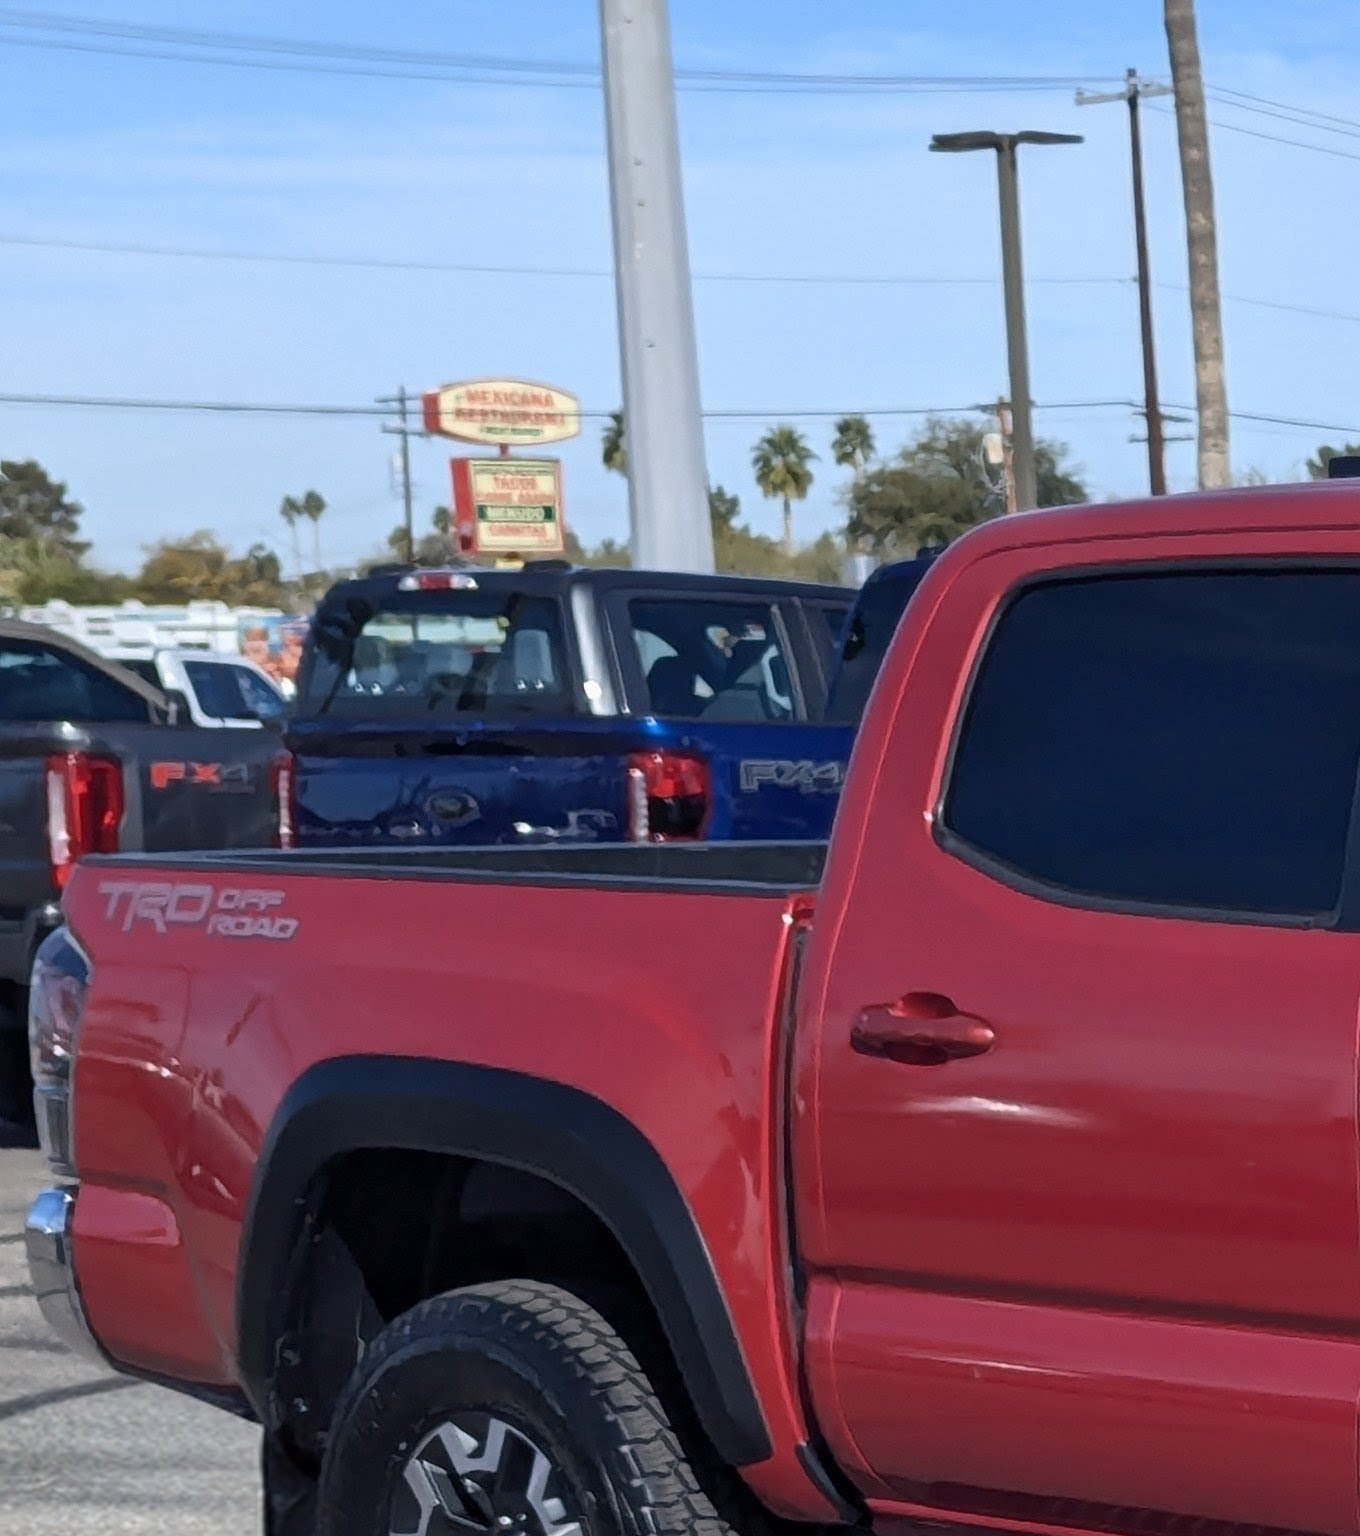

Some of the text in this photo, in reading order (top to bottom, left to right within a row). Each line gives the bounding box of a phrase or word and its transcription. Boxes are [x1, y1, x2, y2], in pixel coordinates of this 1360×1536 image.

[465, 389, 555, 407] MEXICANA
[98, 882, 286, 934] TRD OFF
[206, 913, 299, 938] ROAD
